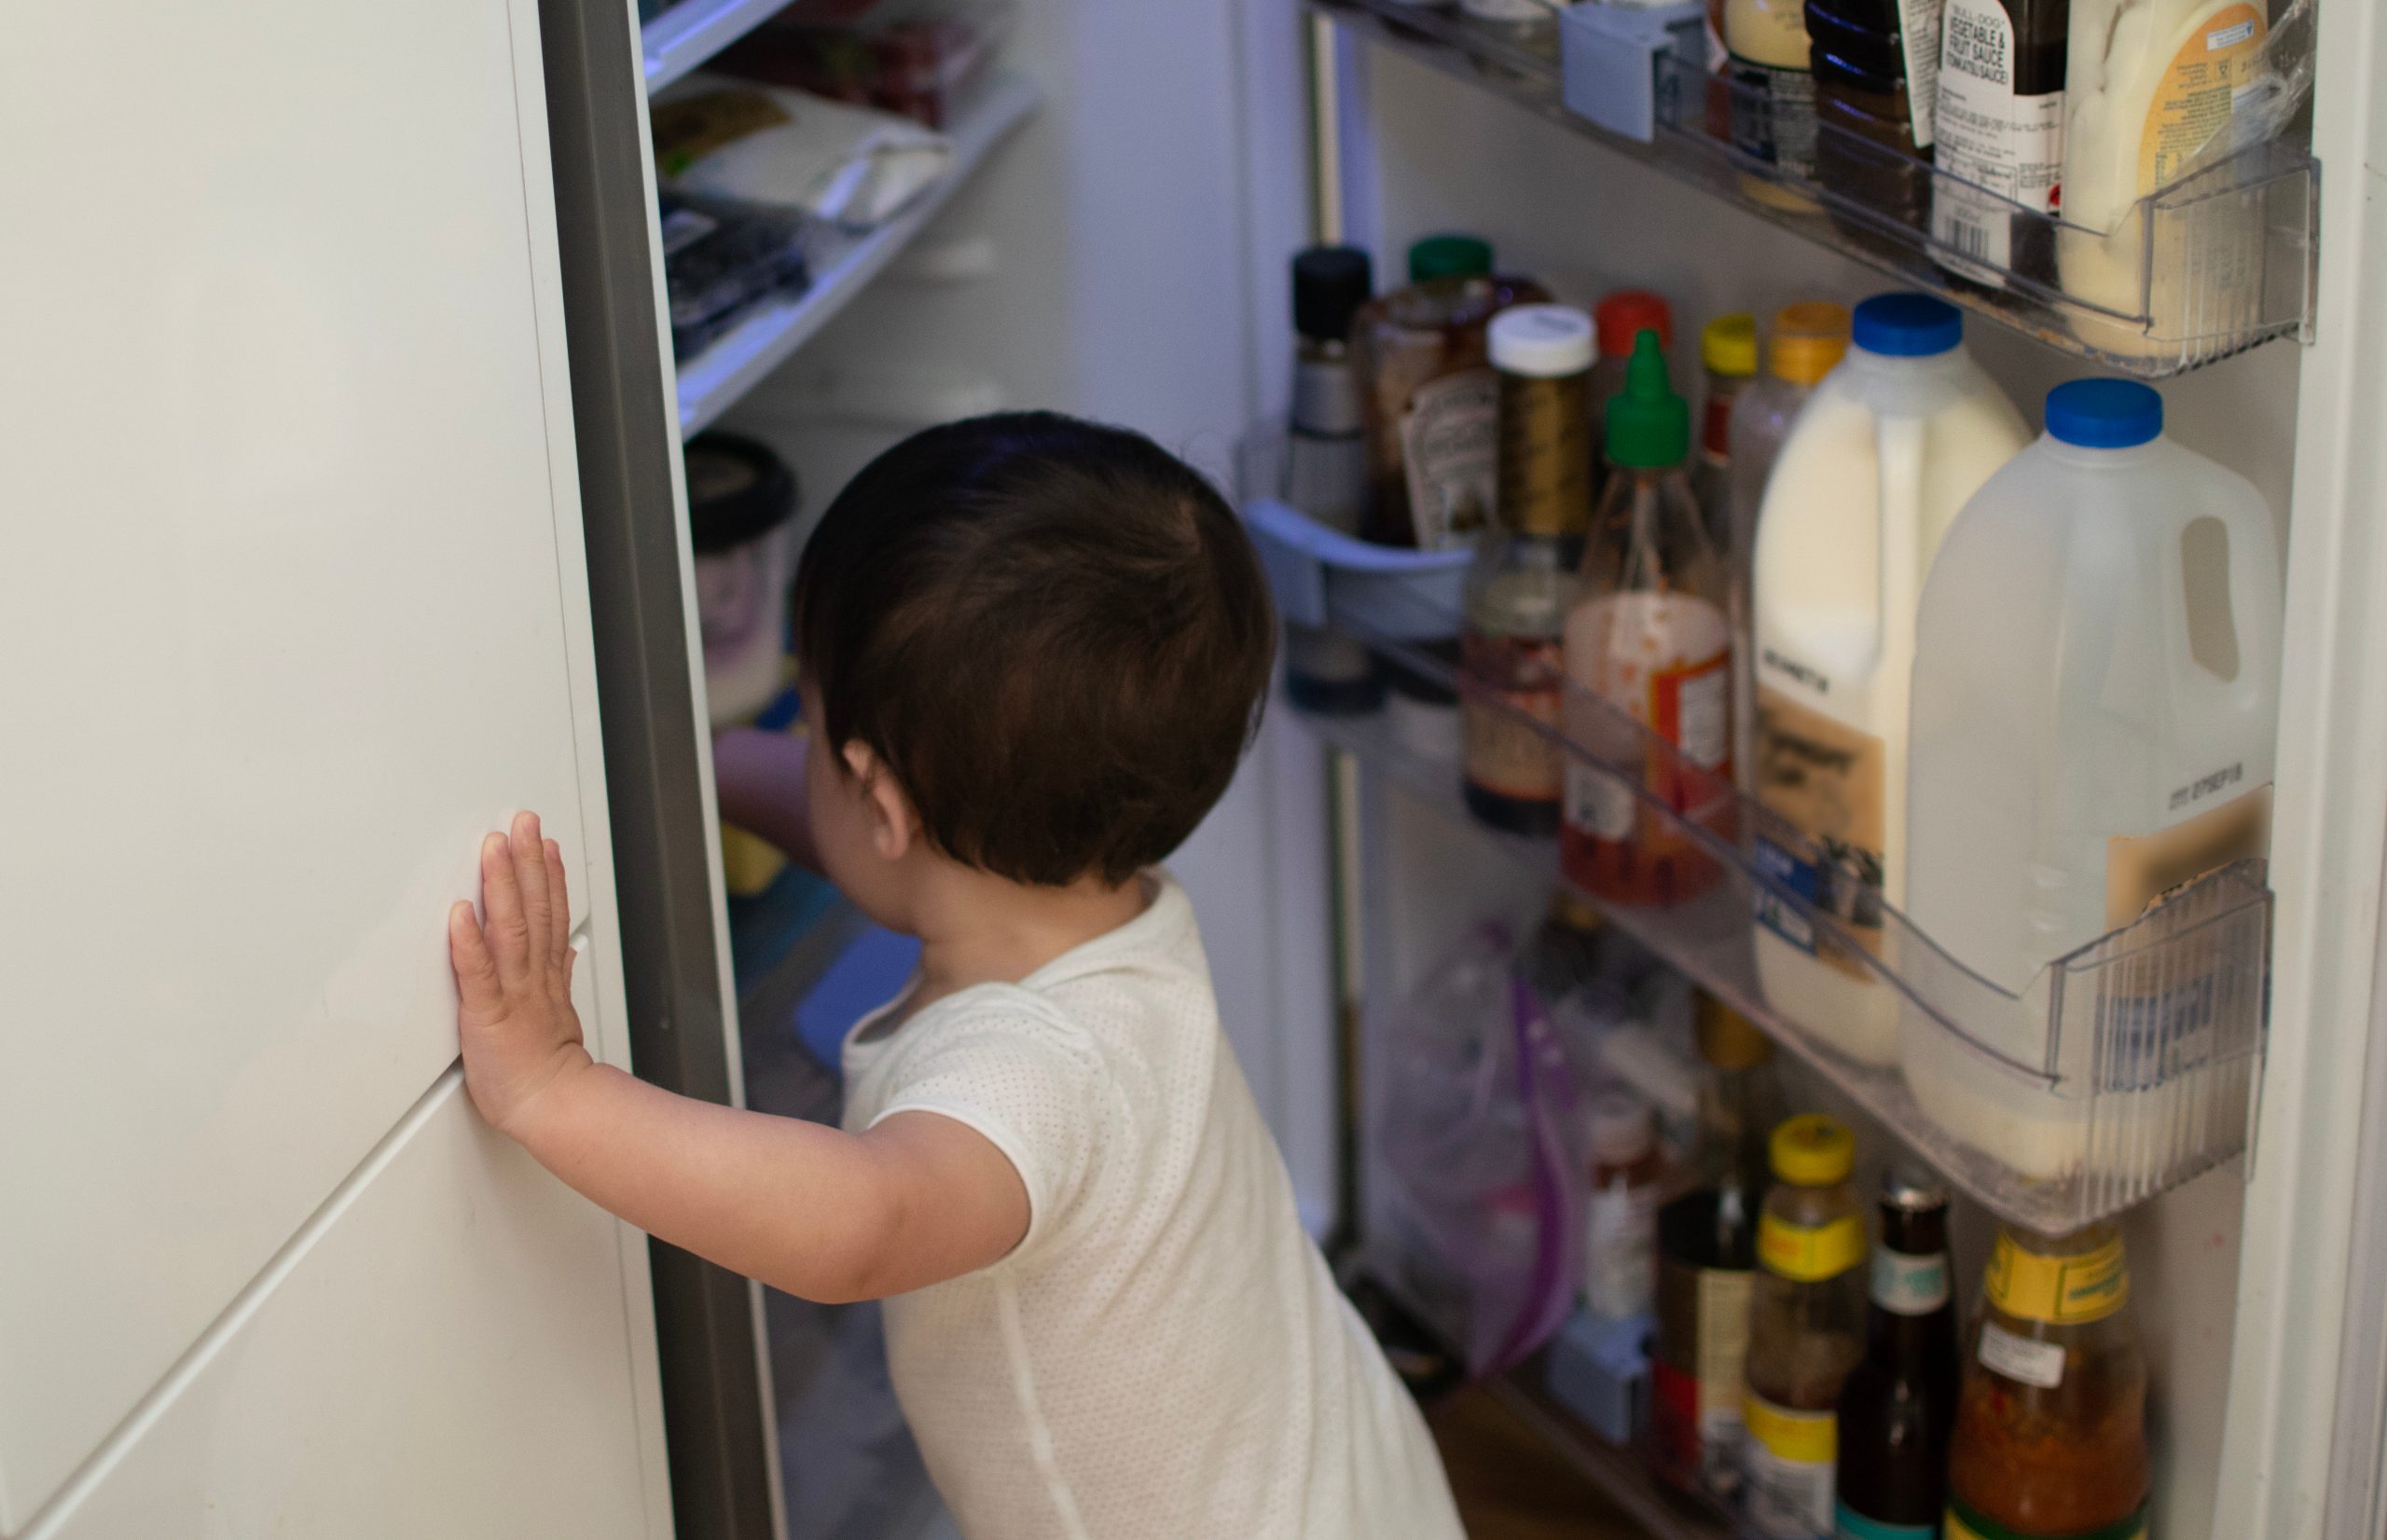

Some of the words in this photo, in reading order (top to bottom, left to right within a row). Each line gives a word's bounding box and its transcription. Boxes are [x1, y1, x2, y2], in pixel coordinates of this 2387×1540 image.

[1949, 34, 1971, 56] FRUIT
[1972, 42, 2004, 69] SAUCE
[1997, 30, 2006, 49] &
